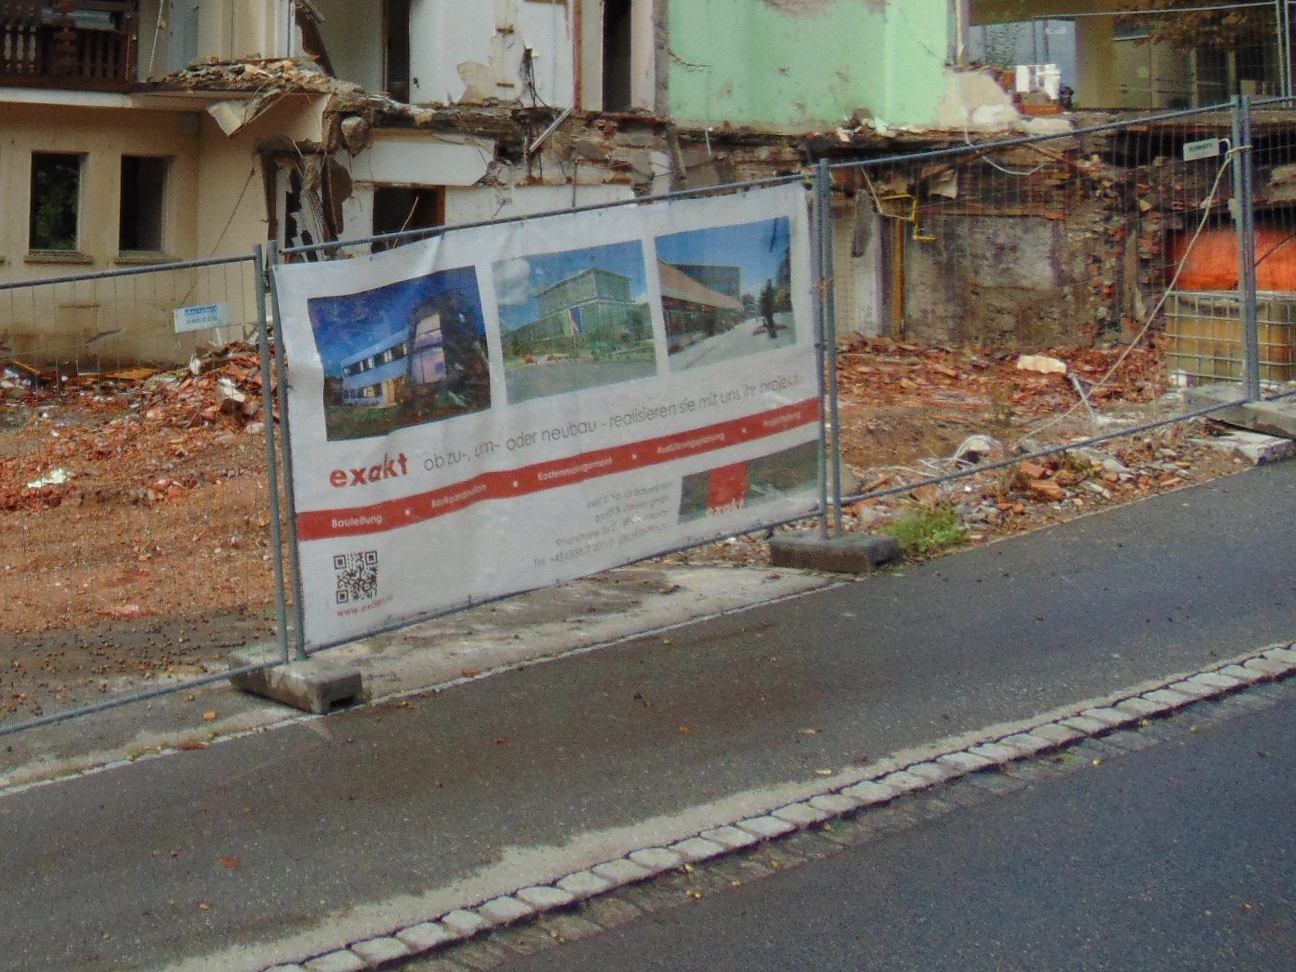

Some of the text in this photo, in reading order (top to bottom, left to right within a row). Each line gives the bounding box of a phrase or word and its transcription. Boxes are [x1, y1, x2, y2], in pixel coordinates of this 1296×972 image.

[423, 454, 445, 471] ob
[474, 440, 501, 458] um-
[506, 431, 538, 451] oder
[541, 419, 597, 442] neubau
[609, 401, 677, 426] realisieren
[679, 397, 697, 414] sie
[329, 452, 408, 488] exakt
[331, 513, 383, 529] Bauleitung
